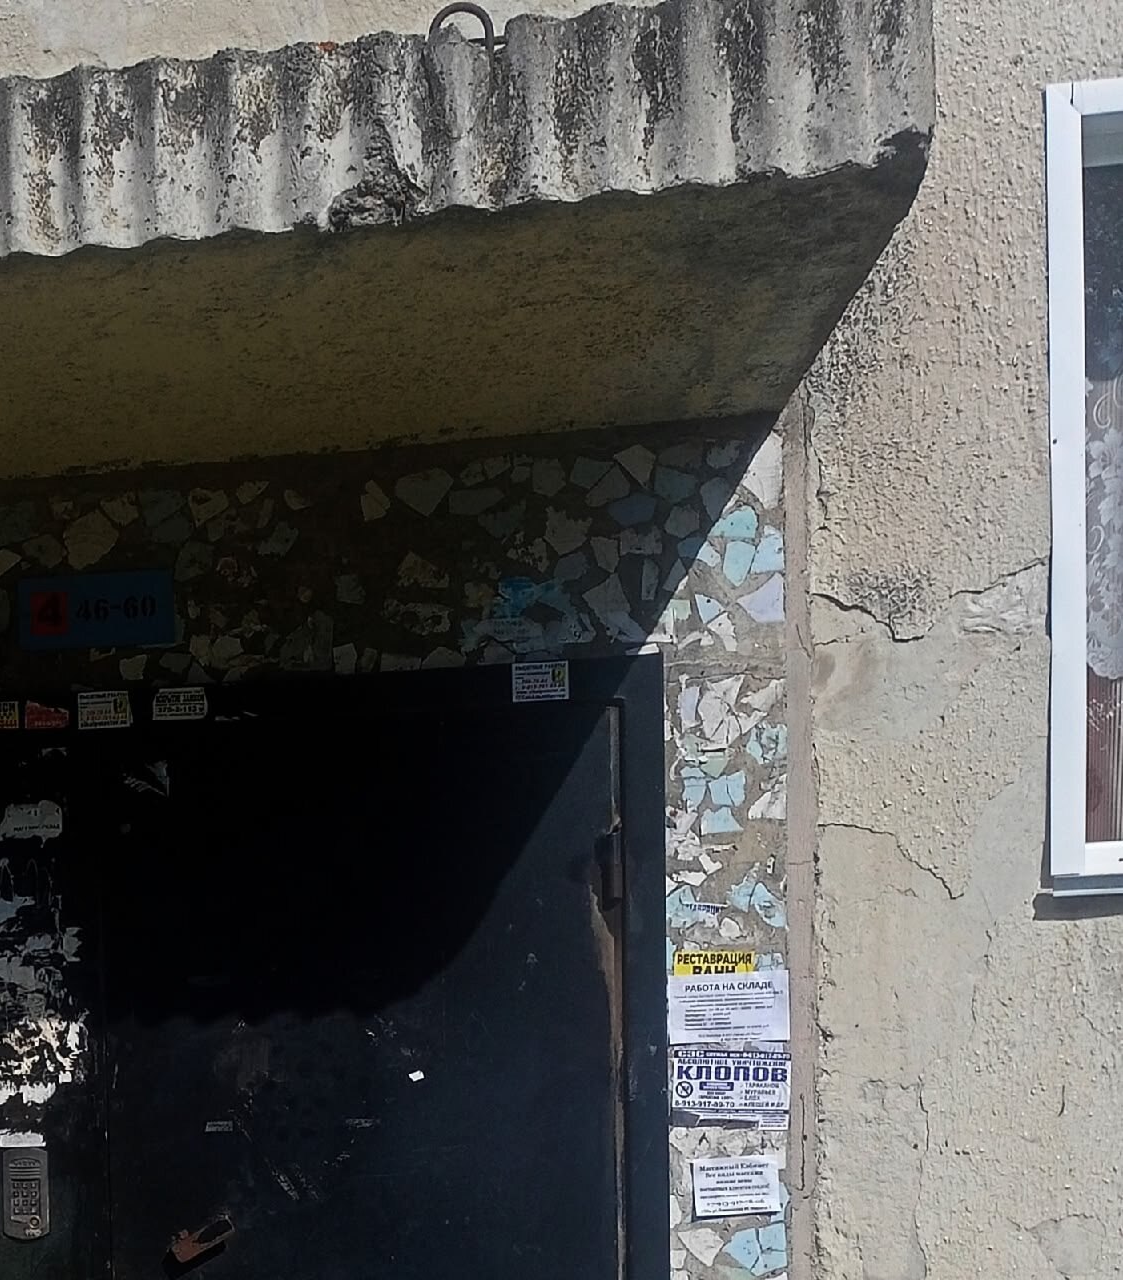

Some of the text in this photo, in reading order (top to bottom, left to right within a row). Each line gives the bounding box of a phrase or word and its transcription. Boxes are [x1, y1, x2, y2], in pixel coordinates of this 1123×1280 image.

[37, 592, 158, 627] 4 46-60
[677, 953, 752, 966] РЕСТАВРАЦИЯ
[685, 981, 774, 993] РАБОТА НА СКЛАДЕ
[677, 1065, 788, 1082] КЛОПОВ
